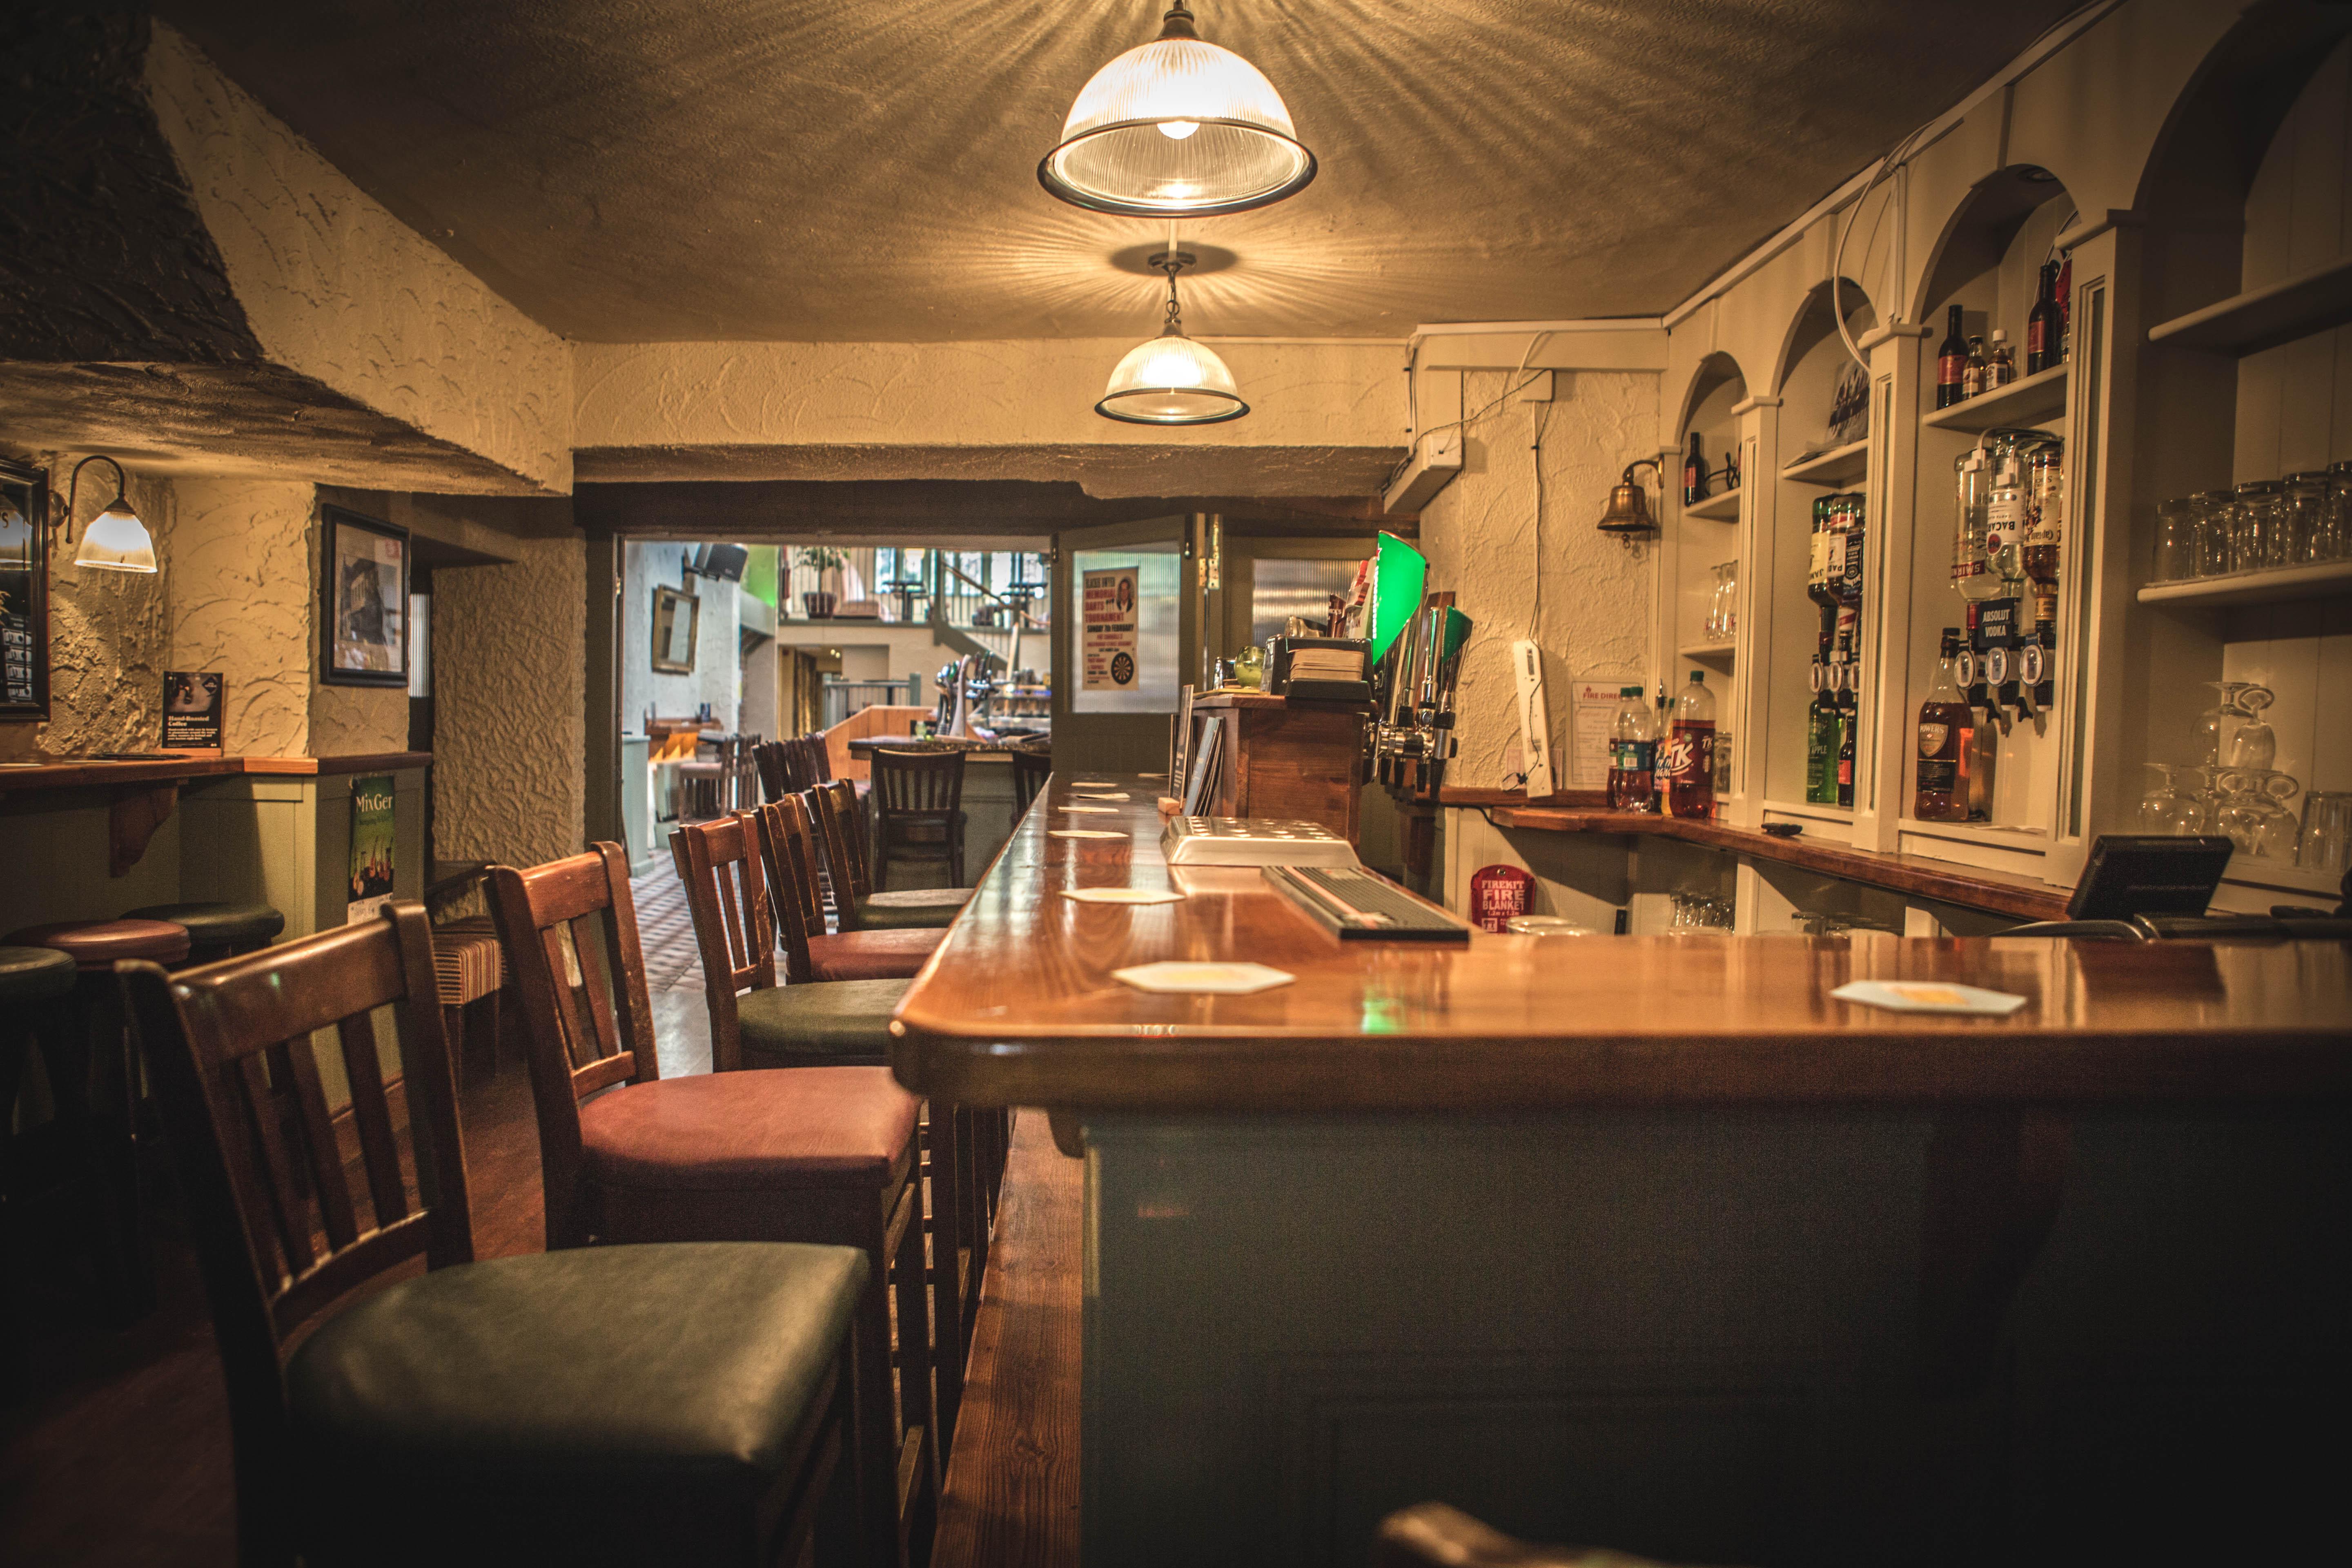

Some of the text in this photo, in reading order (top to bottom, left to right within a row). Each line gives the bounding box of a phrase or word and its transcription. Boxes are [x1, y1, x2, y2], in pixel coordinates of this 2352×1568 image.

[1952, 564, 1980, 576] SMIRN
[1085, 601, 1104, 611] DARTS
[1085, 612, 1124, 623] TOURNAMENT
[1982, 609, 2011, 623] ABSOLUT
[1985, 625, 2006, 637] VODKA
[1920, 725, 1944, 734] POWERS
[1703, 737, 1713, 748] TK
[1672, 742, 1694, 767] TK
[1482, 880, 1524, 889] FIREKIT
[1483, 889, 1525, 900] FIRE
[1483, 900, 1524, 911] BLANKET
